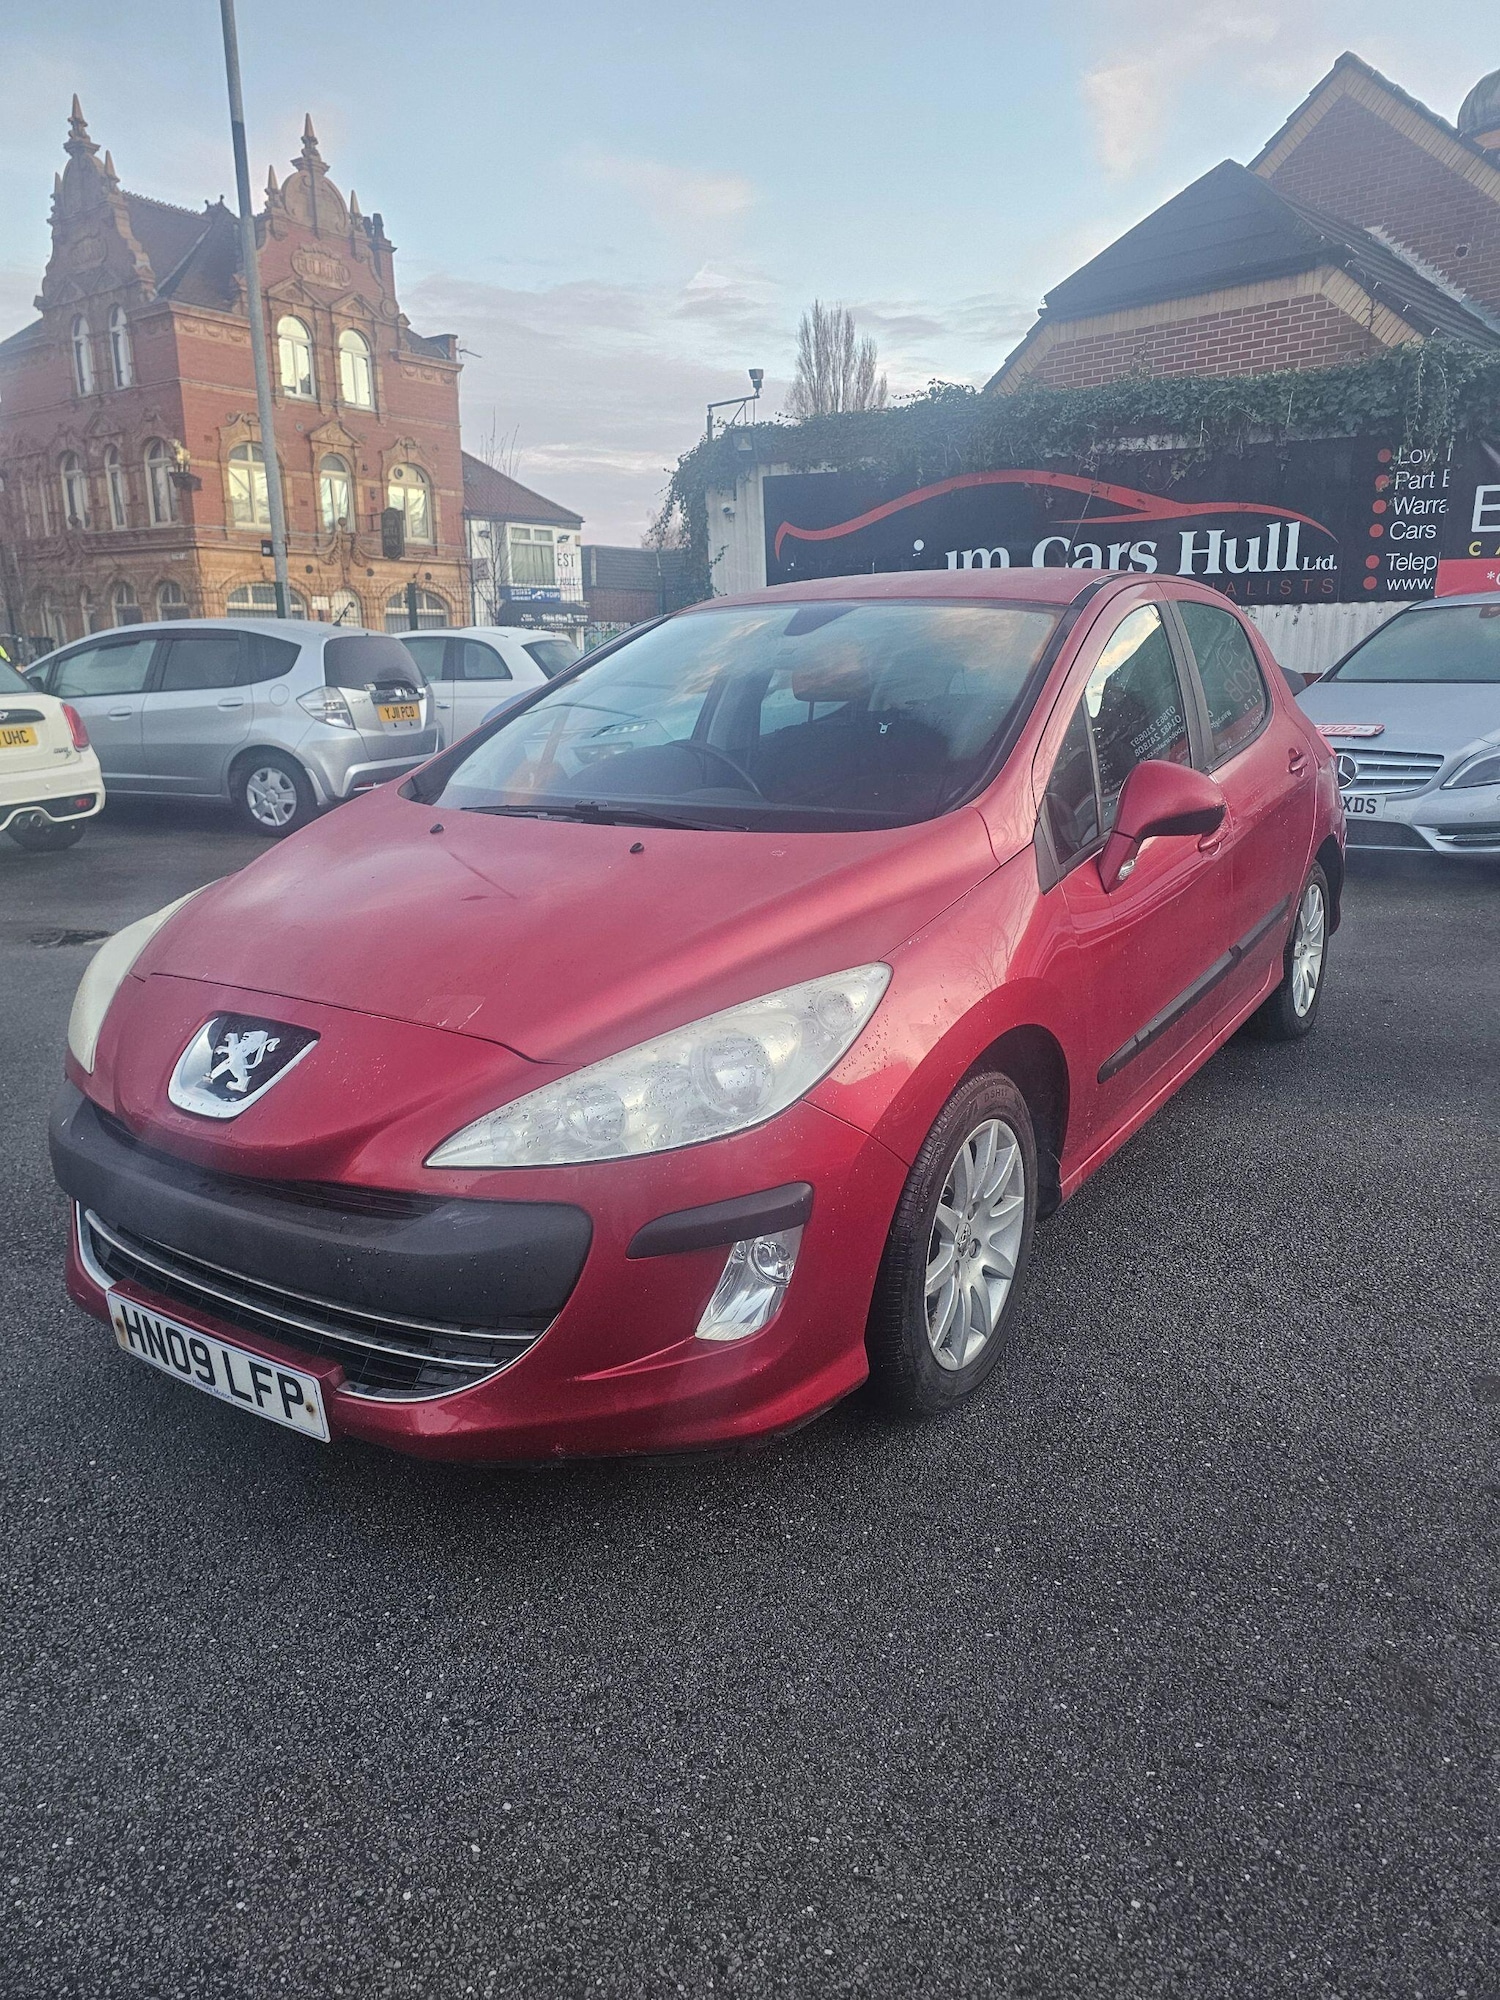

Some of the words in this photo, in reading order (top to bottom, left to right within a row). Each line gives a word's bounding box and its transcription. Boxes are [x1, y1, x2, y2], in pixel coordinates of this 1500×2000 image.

[1395, 470, 1436, 490] Part
[1394, 496, 1450, 515] Warra
[1389, 520, 1437, 540] Cars
[1031, 535, 1158, 575] Cars
[1176, 520, 1301, 576] Hull
[1301, 554, 1338, 571] Ltd.
[557, 552, 575, 568] EST
[1386, 552, 1438, 574] Telep
[1386, 577, 1434, 591] www.
[2, 730, 29, 745] UHC
[1343, 796, 1378, 814] XDS
[120, 1304, 217, 1386] HN09
[221, 1350, 305, 1420] LFP
